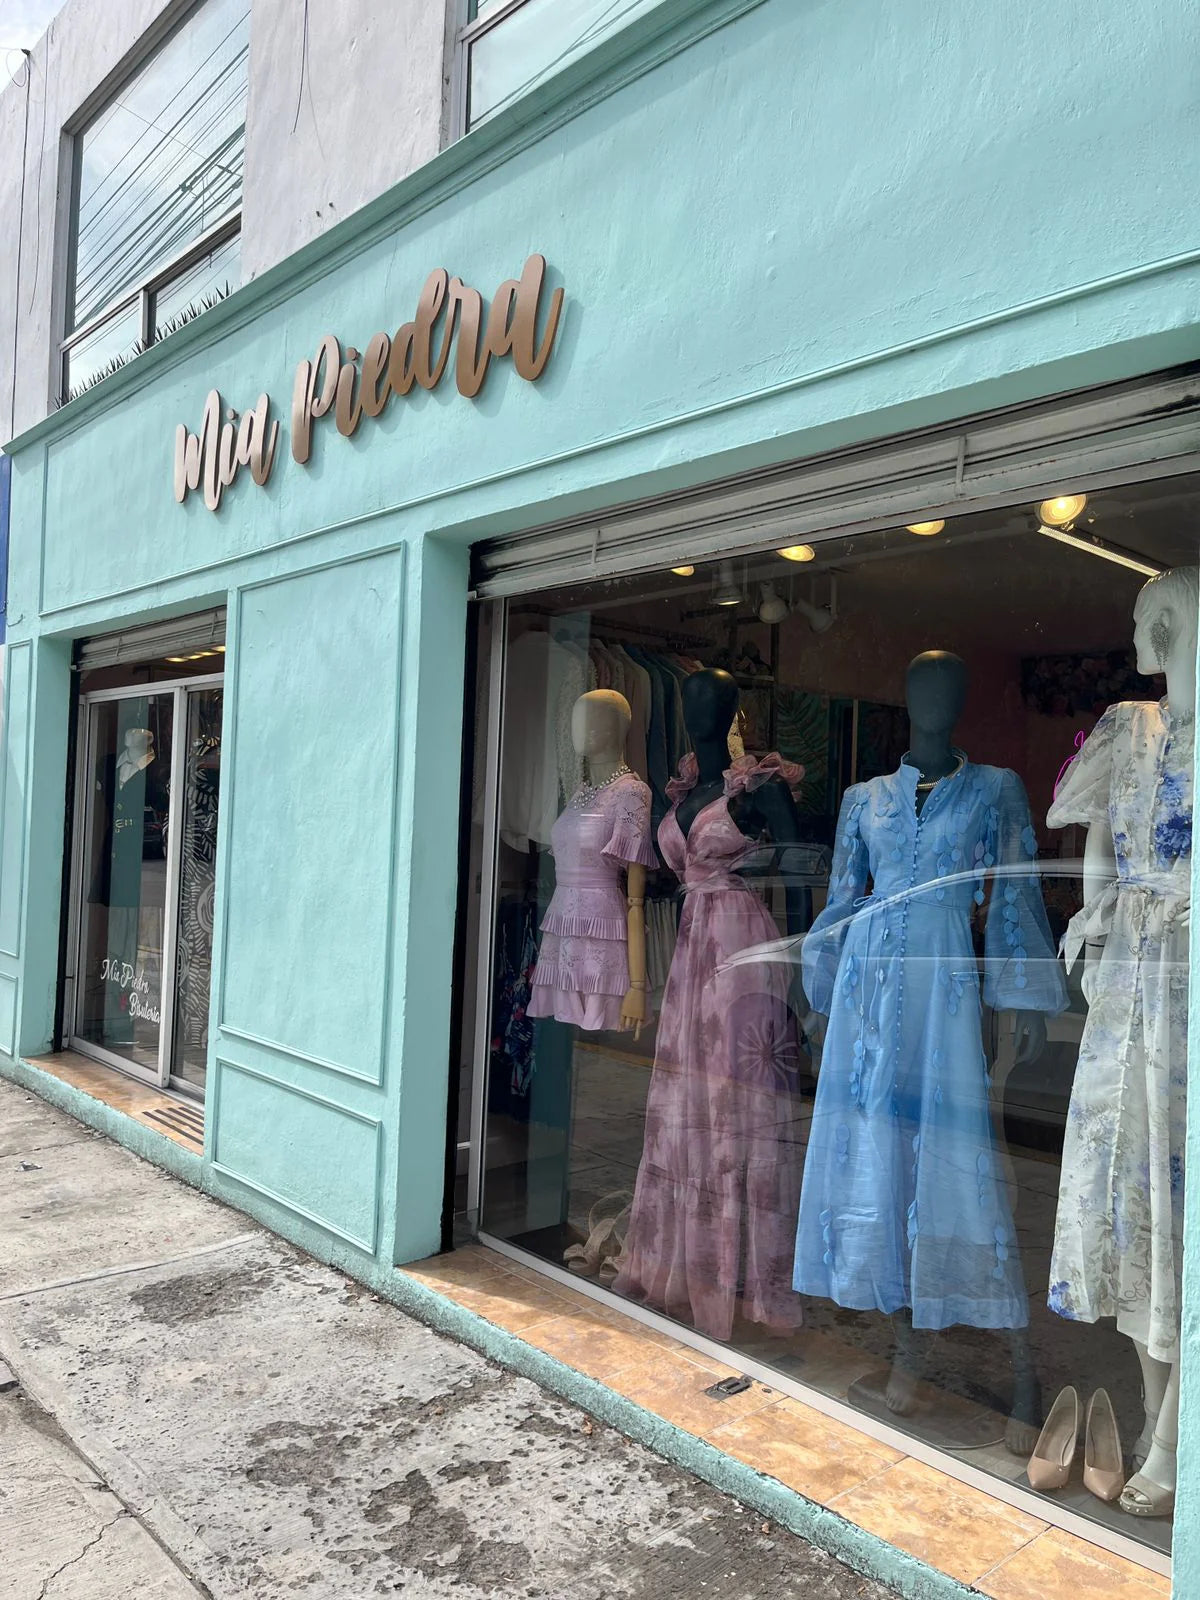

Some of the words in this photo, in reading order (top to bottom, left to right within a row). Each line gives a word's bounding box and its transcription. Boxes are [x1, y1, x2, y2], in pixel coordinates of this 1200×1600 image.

[174, 389, 279, 512] Mia
[291, 253, 565, 464] Piedra
[101, 958, 120, 982] Mia
[120, 962, 149, 994] Piedra
